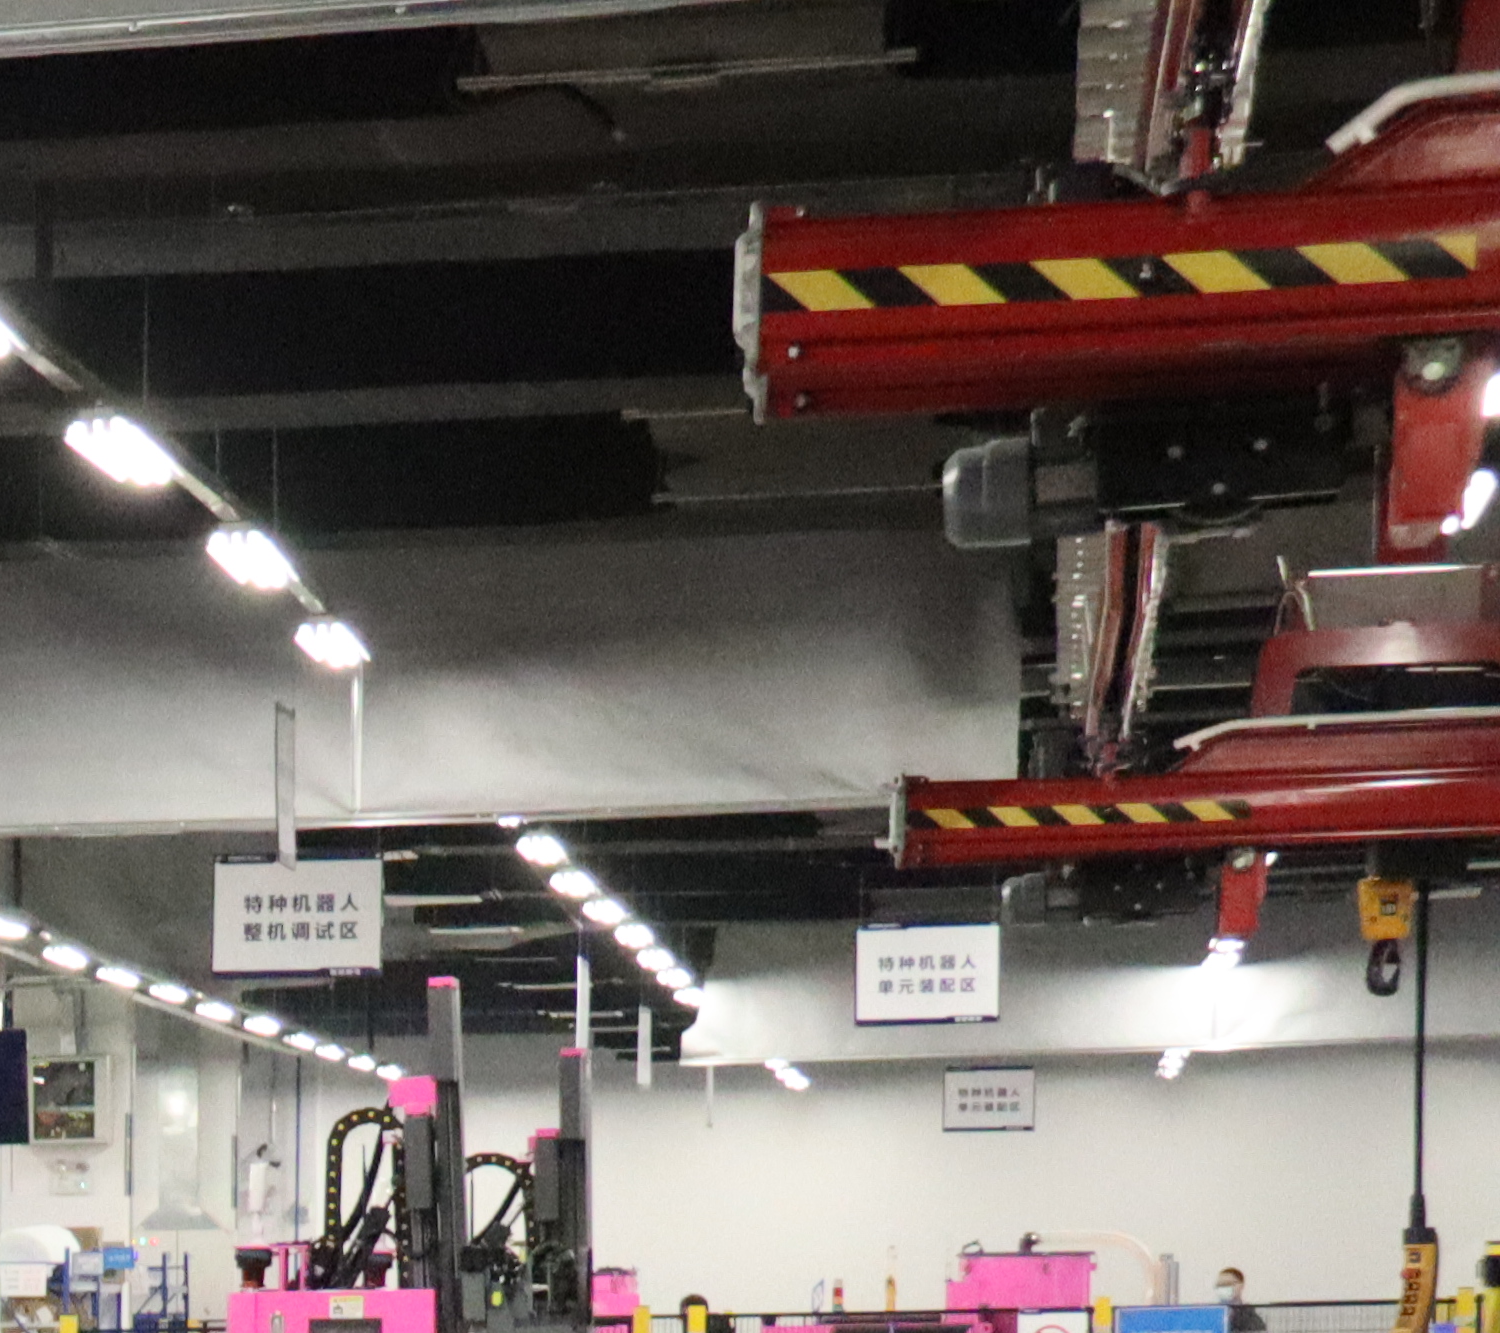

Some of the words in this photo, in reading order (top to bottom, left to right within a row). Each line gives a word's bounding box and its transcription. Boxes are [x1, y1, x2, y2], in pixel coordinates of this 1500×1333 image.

[244, 893, 359, 914] 特种机器人
[244, 922, 358, 941] 整机调试区
[878, 954, 977, 972] 特种机器人
[878, 978, 976, 994] 单元装配区
